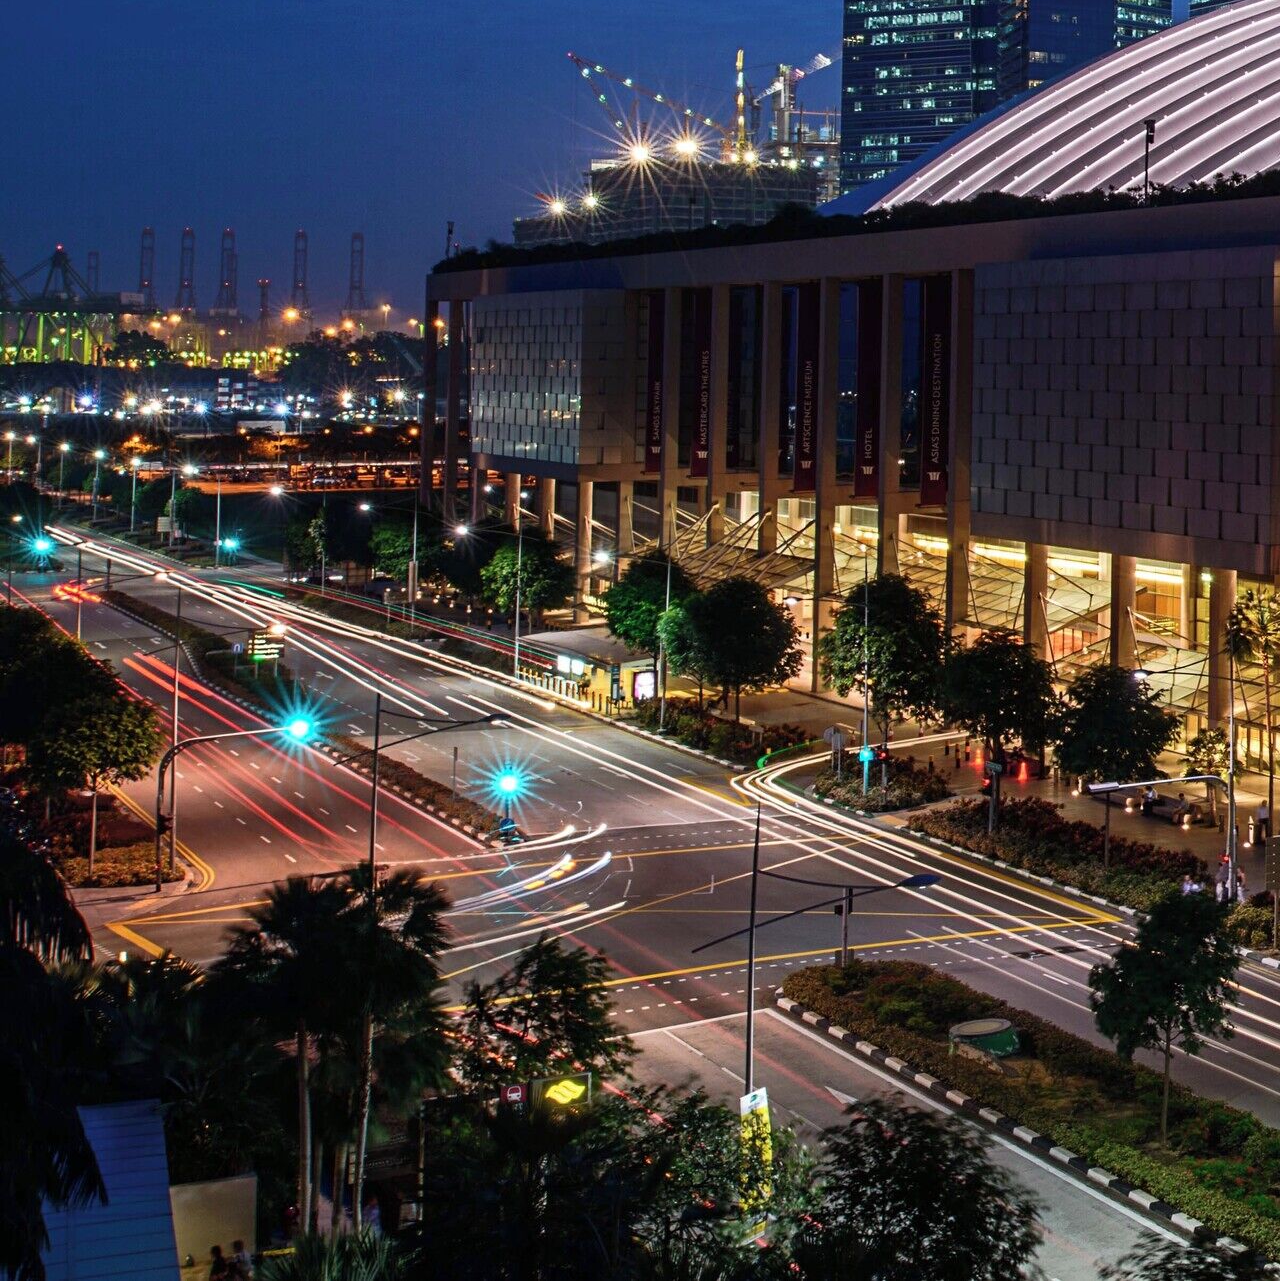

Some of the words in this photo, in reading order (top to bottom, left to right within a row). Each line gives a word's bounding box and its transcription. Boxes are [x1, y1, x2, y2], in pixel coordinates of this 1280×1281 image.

[804, 359, 813, 399] MUSEUM
[932, 333, 942, 398] DESTINATION
[653, 380, 661, 414] SKYPARK
[701, 391, 709, 445] MASTERCARD
[802, 400, 812, 453] ARTSCIENCE
[931, 400, 940, 435] DINING
[864, 428, 873, 459] HOTEL
